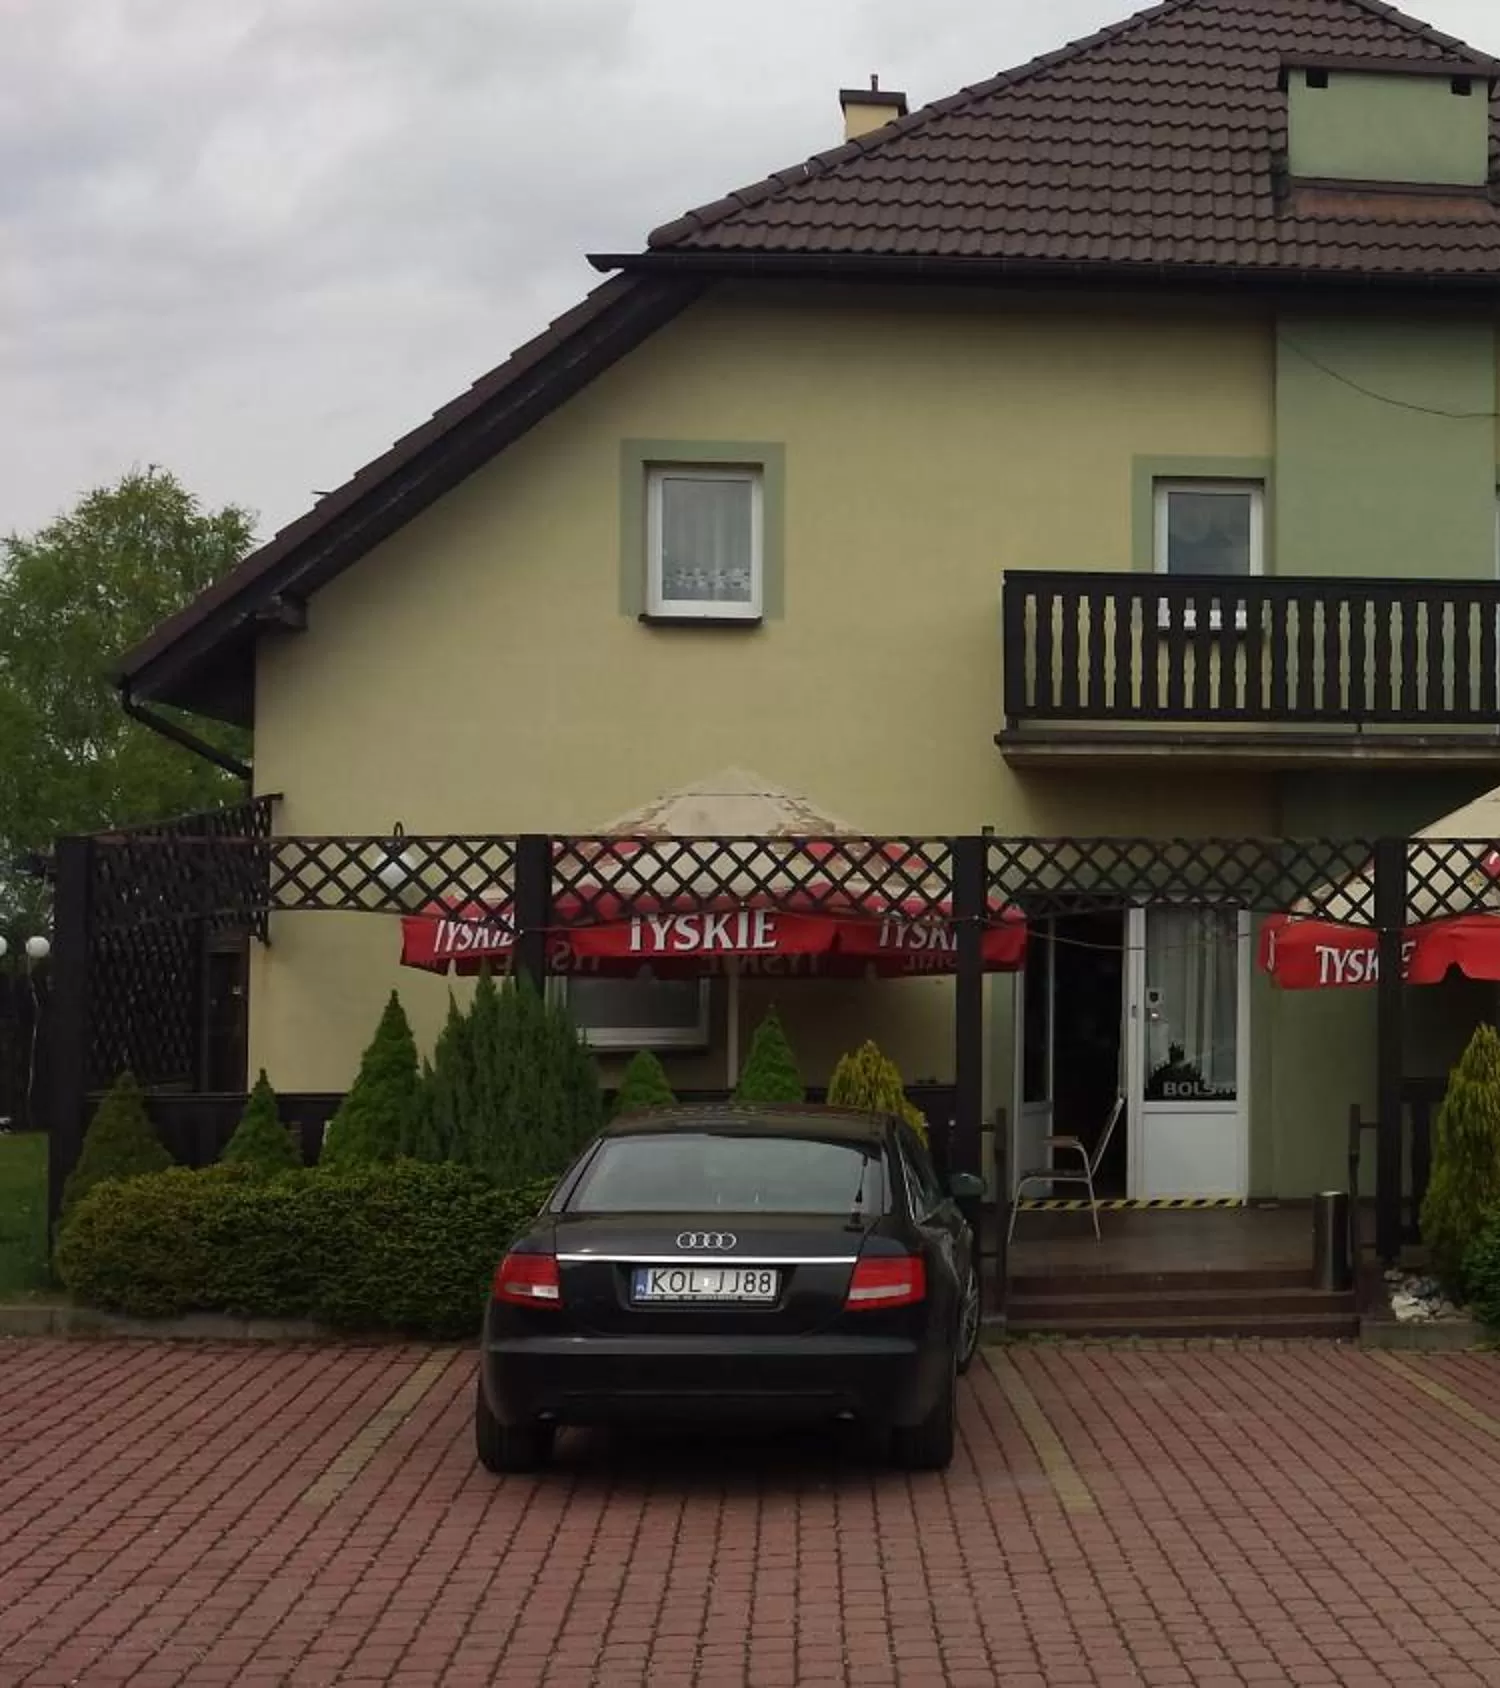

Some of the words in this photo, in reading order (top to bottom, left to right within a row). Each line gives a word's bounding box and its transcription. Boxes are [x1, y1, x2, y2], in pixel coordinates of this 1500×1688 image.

[629, 908, 777, 951] TYSKIE
[651, 1271, 702, 1293] KOL
[714, 1271, 772, 1294] JJ88
